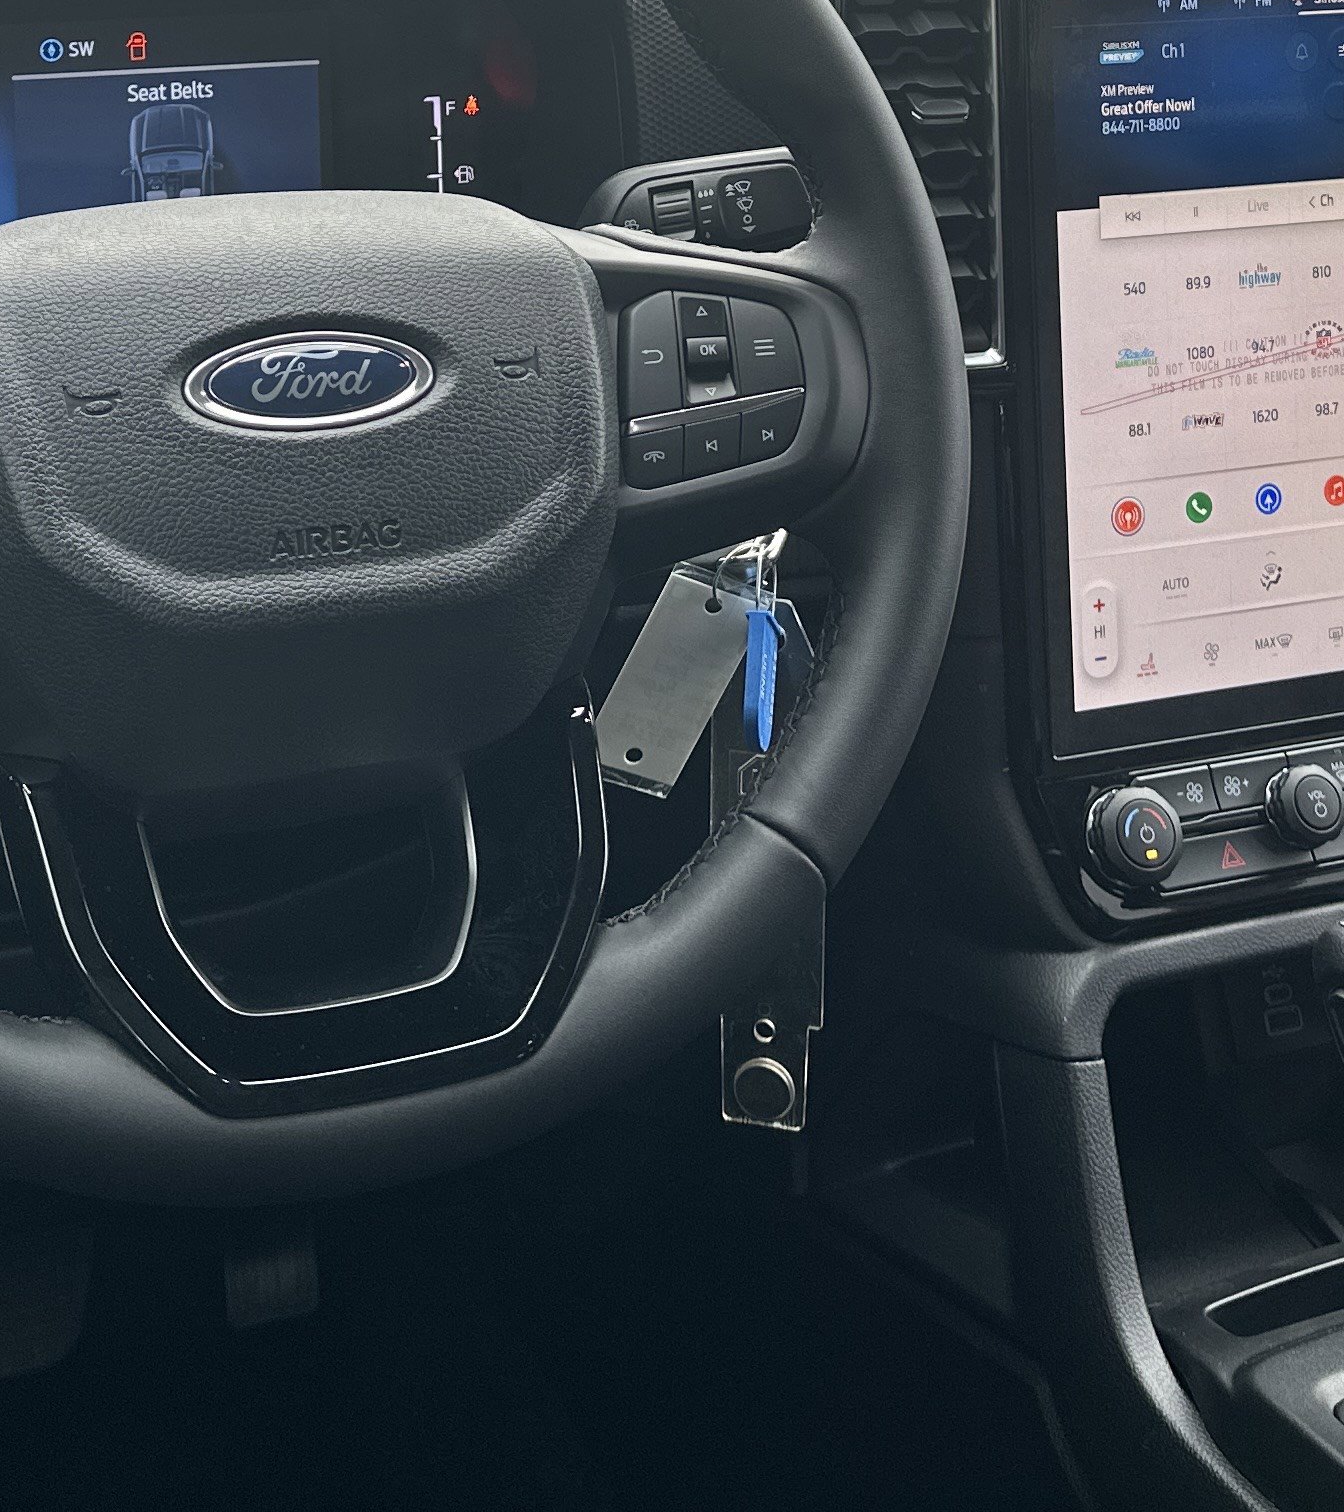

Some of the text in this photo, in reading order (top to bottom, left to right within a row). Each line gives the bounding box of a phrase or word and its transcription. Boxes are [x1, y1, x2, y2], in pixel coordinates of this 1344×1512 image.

[67, 40, 95, 59] SW
[127, 80, 214, 103] Seat Belts
[1100, 82, 1155, 98] XM Preview
[444, 100, 456, 116] F
[1101, 96, 1196, 117] Great Offer Now!
[1102, 116, 1181, 136] 844-711-8800
[1247, 199, 1269, 213] Live
[1319, 193, 1335, 207] Ch
[1238, 269, 1281, 288] highway
[1312, 265, 1331, 279] 810
[1123, 281, 1146, 296] 540
[1186, 276, 1211, 290] 89.9
[699, 343, 717, 357] OK
[1186, 345, 1215, 360] 1080
[1251, 339, 1275, 354] 94.7
[251, 348, 372, 403] Ford
[1147, 365, 1159, 378] DO
[1165, 363, 1183, 376] NOT
[1191, 359, 1219, 373] TOUCH
[1212, 376, 1223, 389] IS
[1229, 374, 1242, 387] TO
[1247, 371, 1258, 385] BE
[1264, 368, 1305, 384] REMOVED
[1252, 408, 1279, 424] 1620
[1315, 401, 1339, 416] 98.7
[1128, 422, 1151, 437] 88.1
[269, 519, 403, 563] AIRBAG
[1162, 576, 1190, 591] AUTO
[1094, 624, 1106, 640] HI
[1255, 635, 1276, 651] MAX
[1307, 789, 1325, 800] VOL
